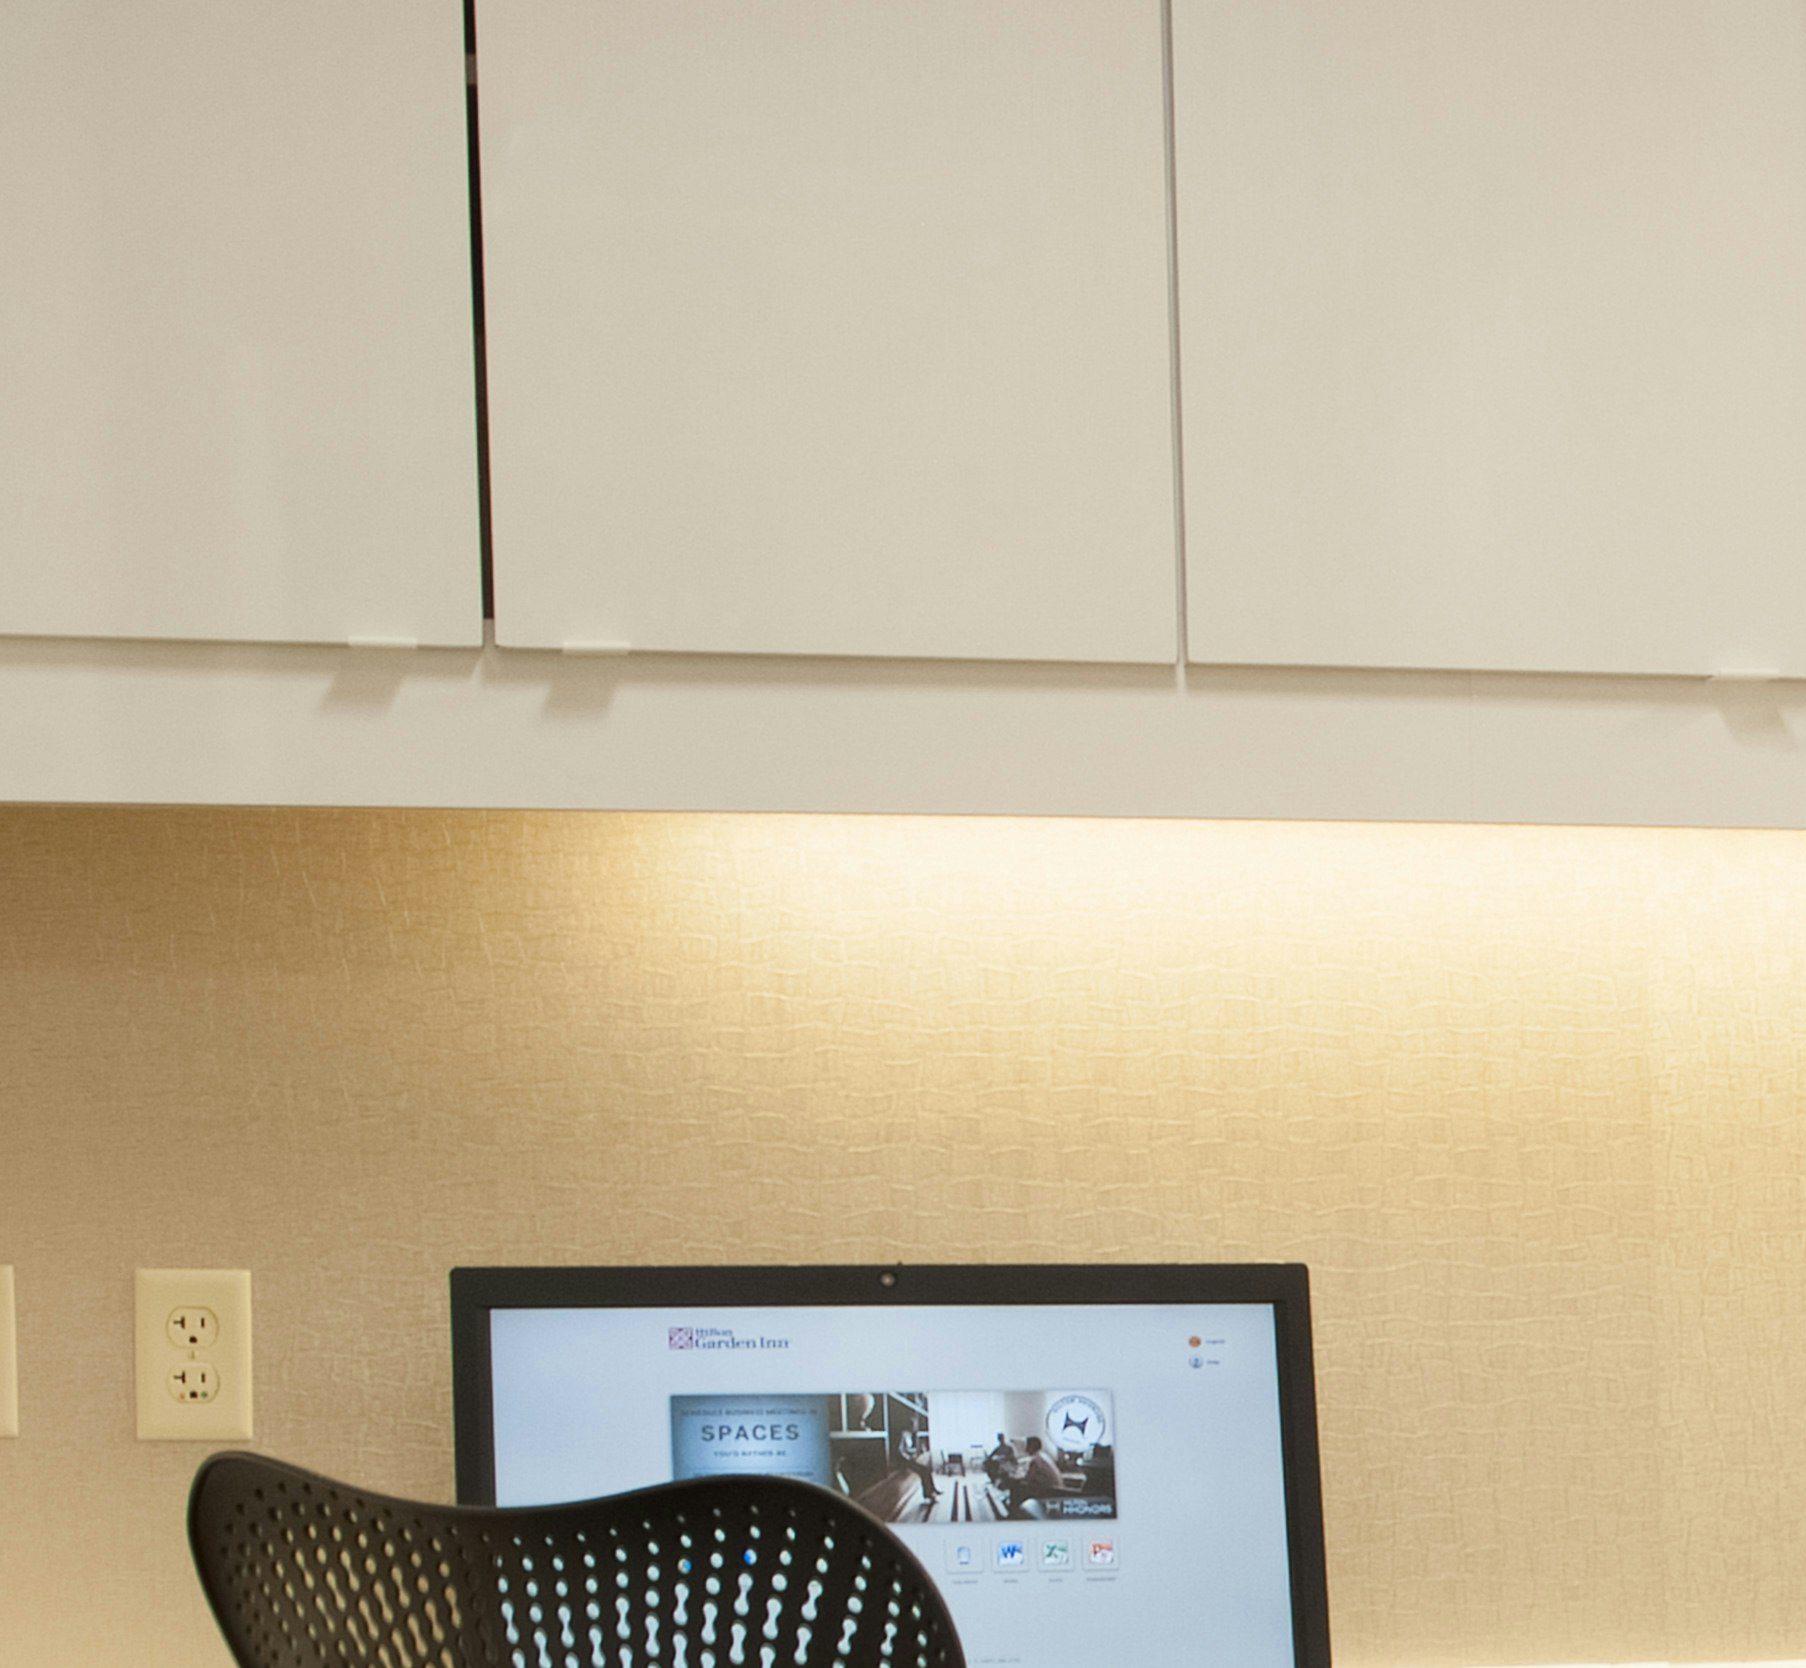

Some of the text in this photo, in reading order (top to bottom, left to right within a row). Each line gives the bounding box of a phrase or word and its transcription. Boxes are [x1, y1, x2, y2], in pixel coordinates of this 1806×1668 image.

[695, 1336, 789, 1349] Garden Inn
[700, 1423, 800, 1442] SPACES
